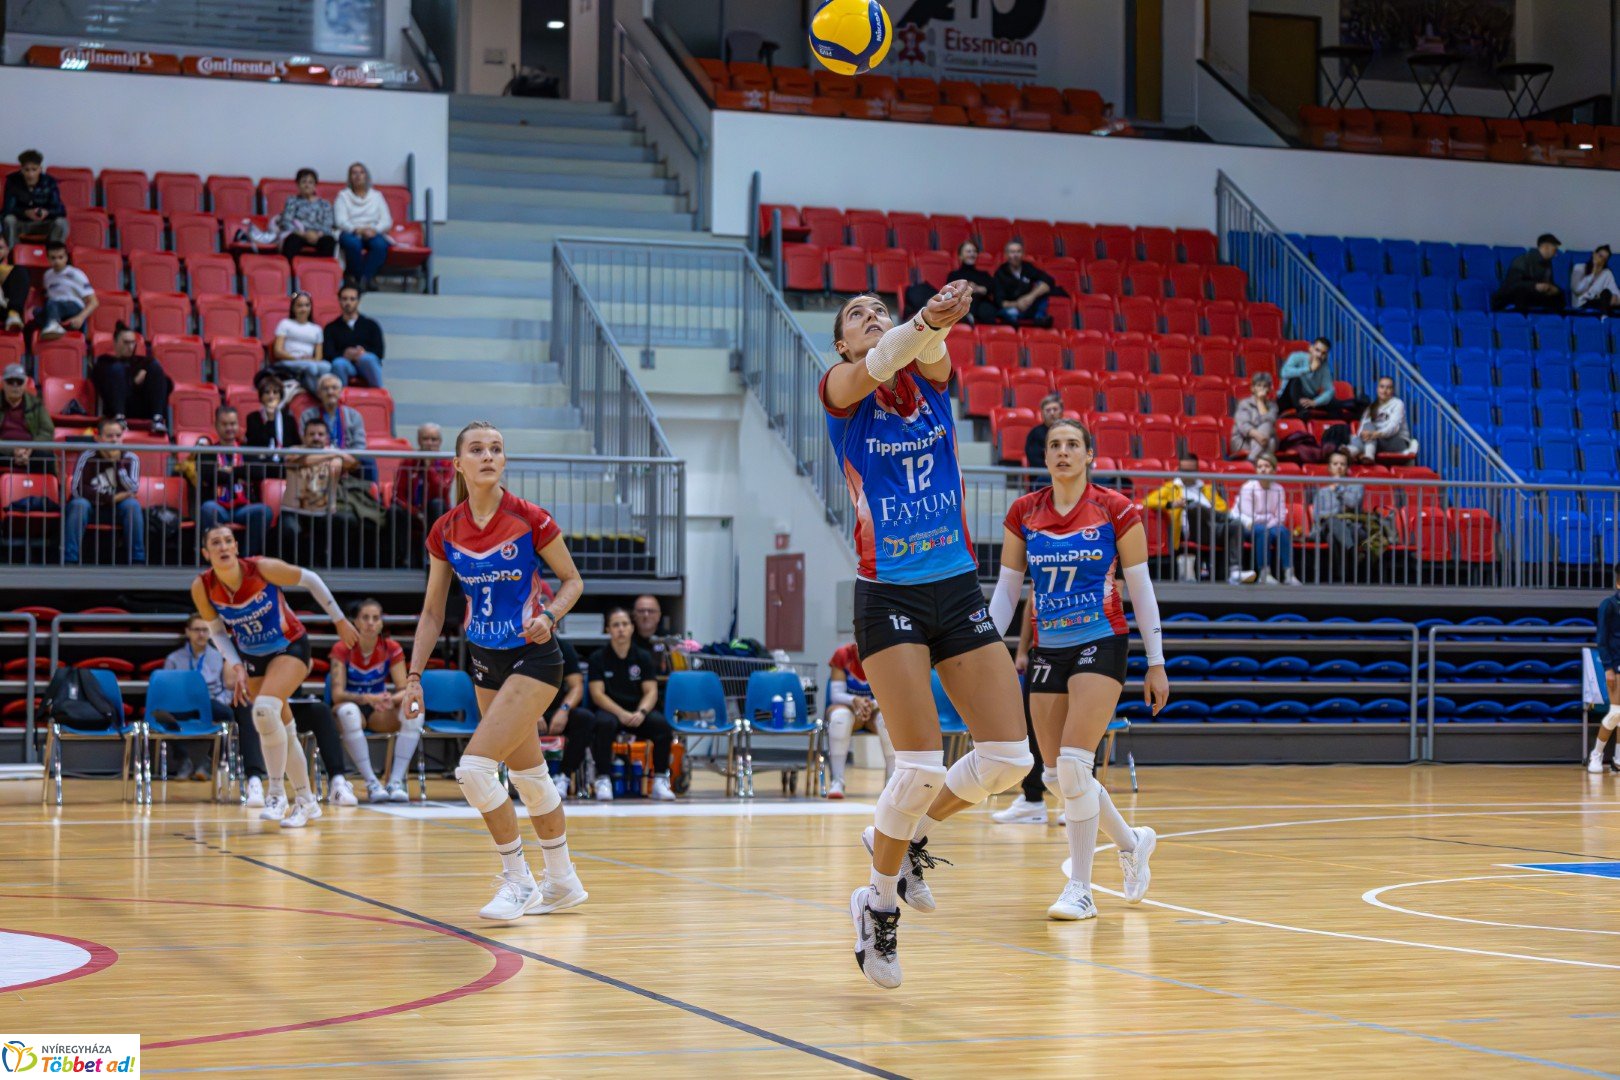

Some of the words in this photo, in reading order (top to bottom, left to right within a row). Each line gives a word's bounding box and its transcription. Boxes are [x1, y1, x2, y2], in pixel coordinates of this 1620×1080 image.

[945, 27, 1037, 57] Eissmann
[198, 56, 277, 75] Continental
[902, 453, 935, 495] 12
[1041, 566, 1078, 594] 77
[481, 586, 493, 617] 3
[241, 619, 263, 636] 13
[1032, 664, 1052, 683] 77
